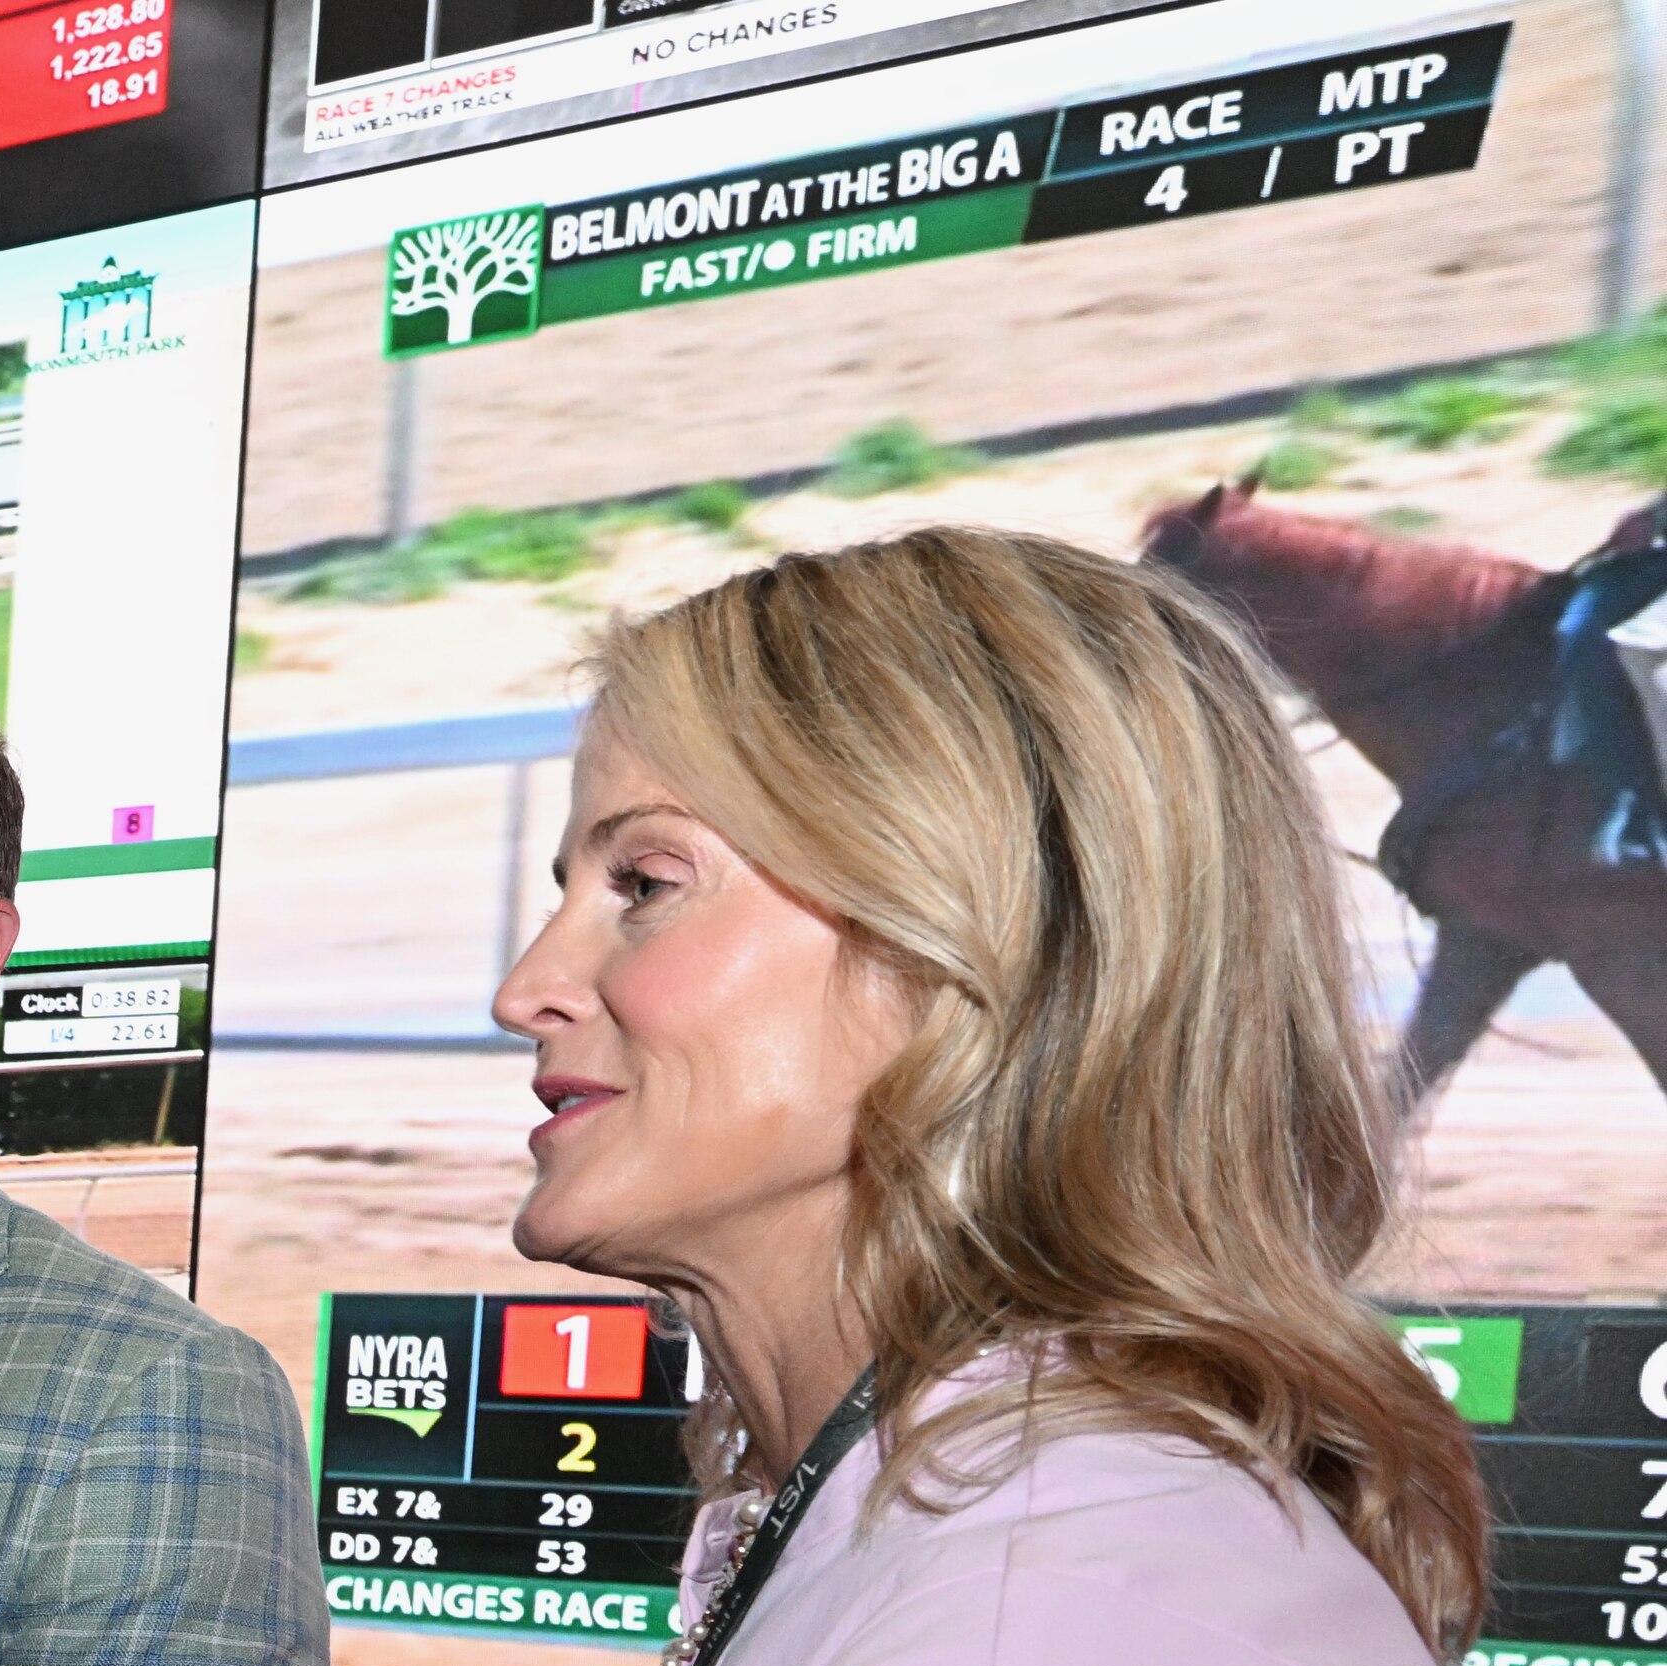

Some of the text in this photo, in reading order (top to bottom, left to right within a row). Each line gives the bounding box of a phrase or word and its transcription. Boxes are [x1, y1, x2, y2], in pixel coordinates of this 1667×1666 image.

[51, 0, 164, 44] 1,528.80
[631, 3, 839, 66] NO CHANGES
[50, 31, 163, 82] 1,222.65
[86, 69, 158, 109] 18.91
[316, 65, 516, 122] RACE 7 CHANGES
[1318, 52, 1448, 116] MTP
[316, 90, 513, 141] ALL WEATHER TRACK
[1099, 90, 1243, 156] RACE
[1335, 121, 1424, 184] PT
[551, 130, 1021, 262] BELMONT AT THE BIG A
[1144, 165, 1187, 213] 4
[806, 215, 917, 270] FIRM
[137, 335, 186, 355] PARK
[127, 812, 140, 835] 8
[21, 988, 171, 1015] Clock 0:38.82
[50, 1024, 167, 1043] 1/4 22.61
[348, 1334, 448, 1380] NYRA
[556, 1314, 590, 1389] 1
[1402, 1326, 1462, 1402] 5
[346, 1380, 446, 1410] BETS
[557, 1422, 597, 1472] 2
[337, 1488, 593, 1526] EX 7& 29
[770, 1461, 819, 1539] 1/ST
[330, 1533, 586, 1574] DD 7& 53
[1621, 1545, 1667, 1586] 5
[326, 1576, 524, 1622] CHANGES
[533, 1588, 647, 1632] RACE
